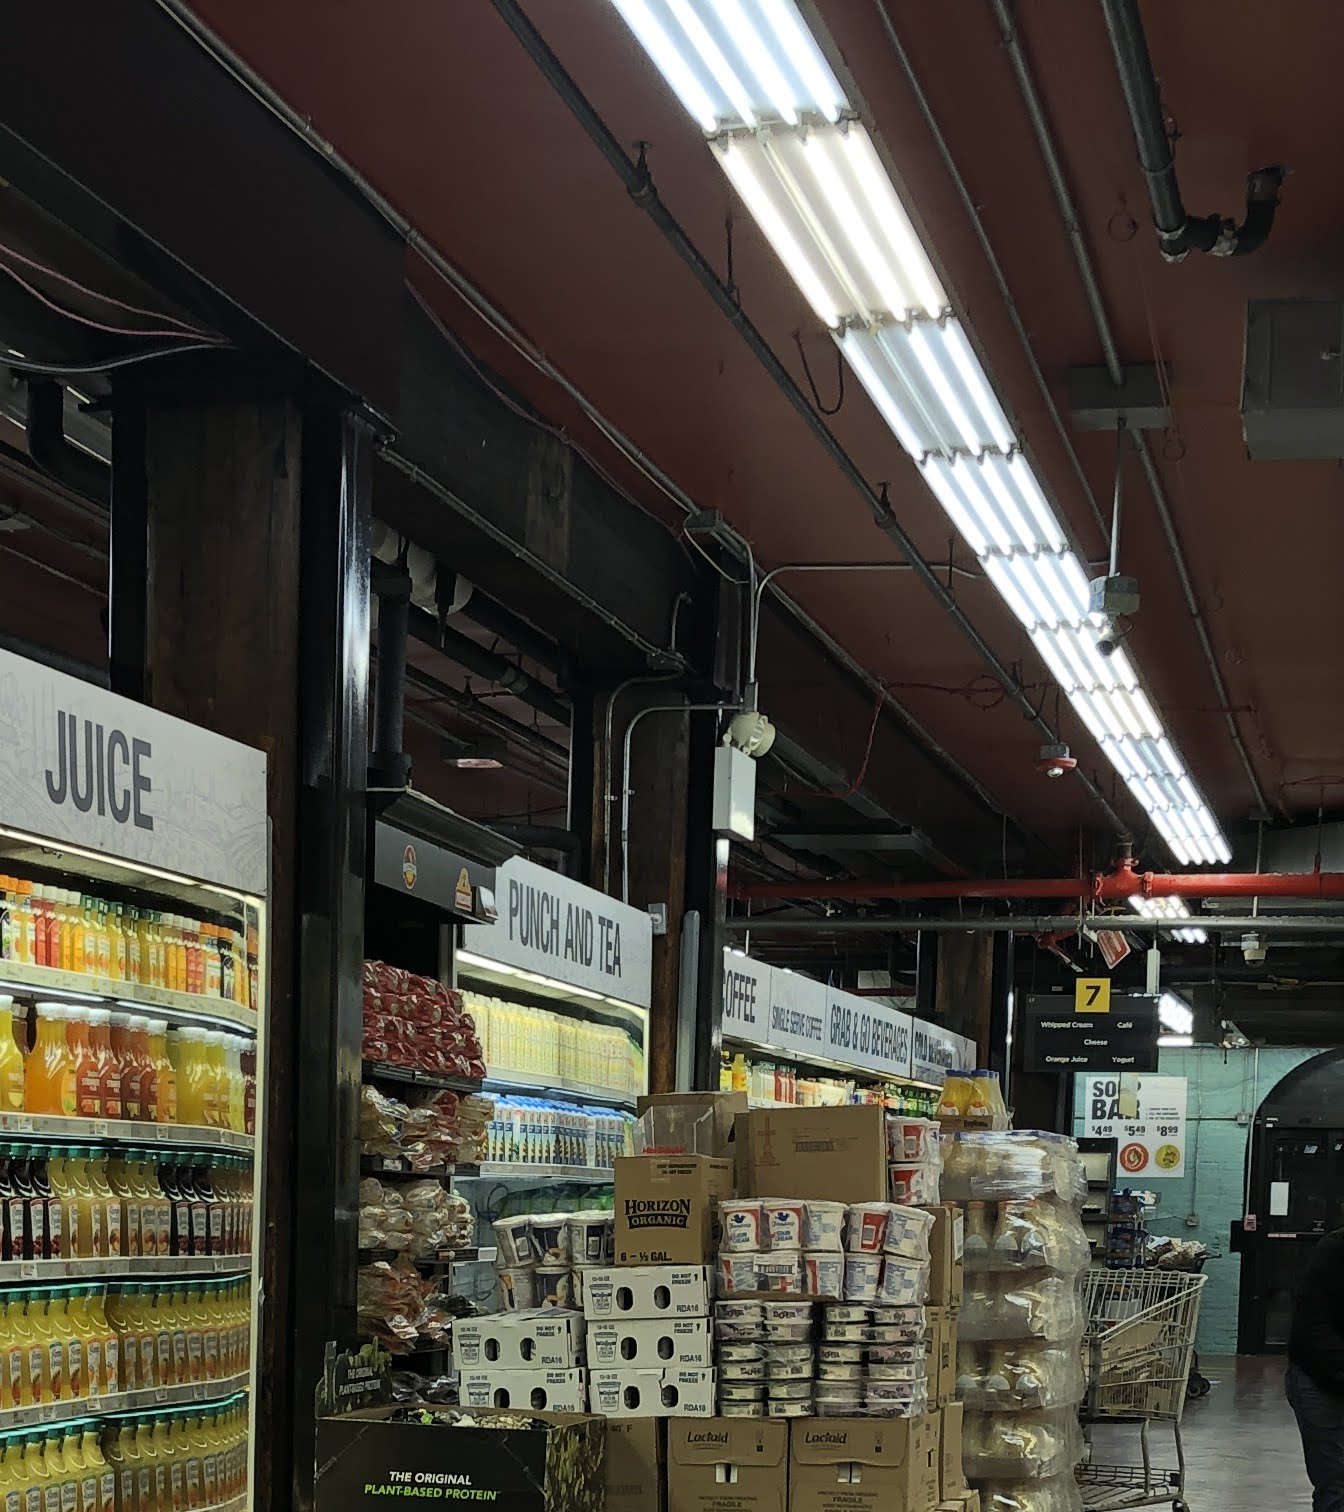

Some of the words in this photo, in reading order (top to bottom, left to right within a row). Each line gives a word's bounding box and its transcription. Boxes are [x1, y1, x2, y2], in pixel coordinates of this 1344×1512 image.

[46, 711, 154, 830] JUICE
[509, 879, 560, 958] PUNCH
[564, 902, 594, 968] AND
[598, 915, 622, 978] TEA
[1085, 985, 1102, 1006] 7
[1041, 1021, 1071, 1029] Whipped
[830, 1004, 851, 1048] GRAB
[852, 1012, 859, 1050] &
[860, 1016, 871, 1053] GO
[872, 1019, 908, 1064] BEVERAGES
[1045, 1056, 1069, 1065] Orange
[1112, 1056, 1135, 1064] Yogurt
[1093, 1081, 1141, 1098] SO
[625, 1198, 692, 1216] HORIZON
[630, 1215, 686, 1227] ORGANIC
[687, 1430, 728, 1445] Lactaid
[805, 1430, 847, 1446] Lactaid
[389, 1471, 412, 1485] THE
[415, 1472, 472, 1486] ORIGINAL
[364, 1484, 442, 1499] PLANT-BASED
[445, 1487, 497, 1501] PROTEIN
